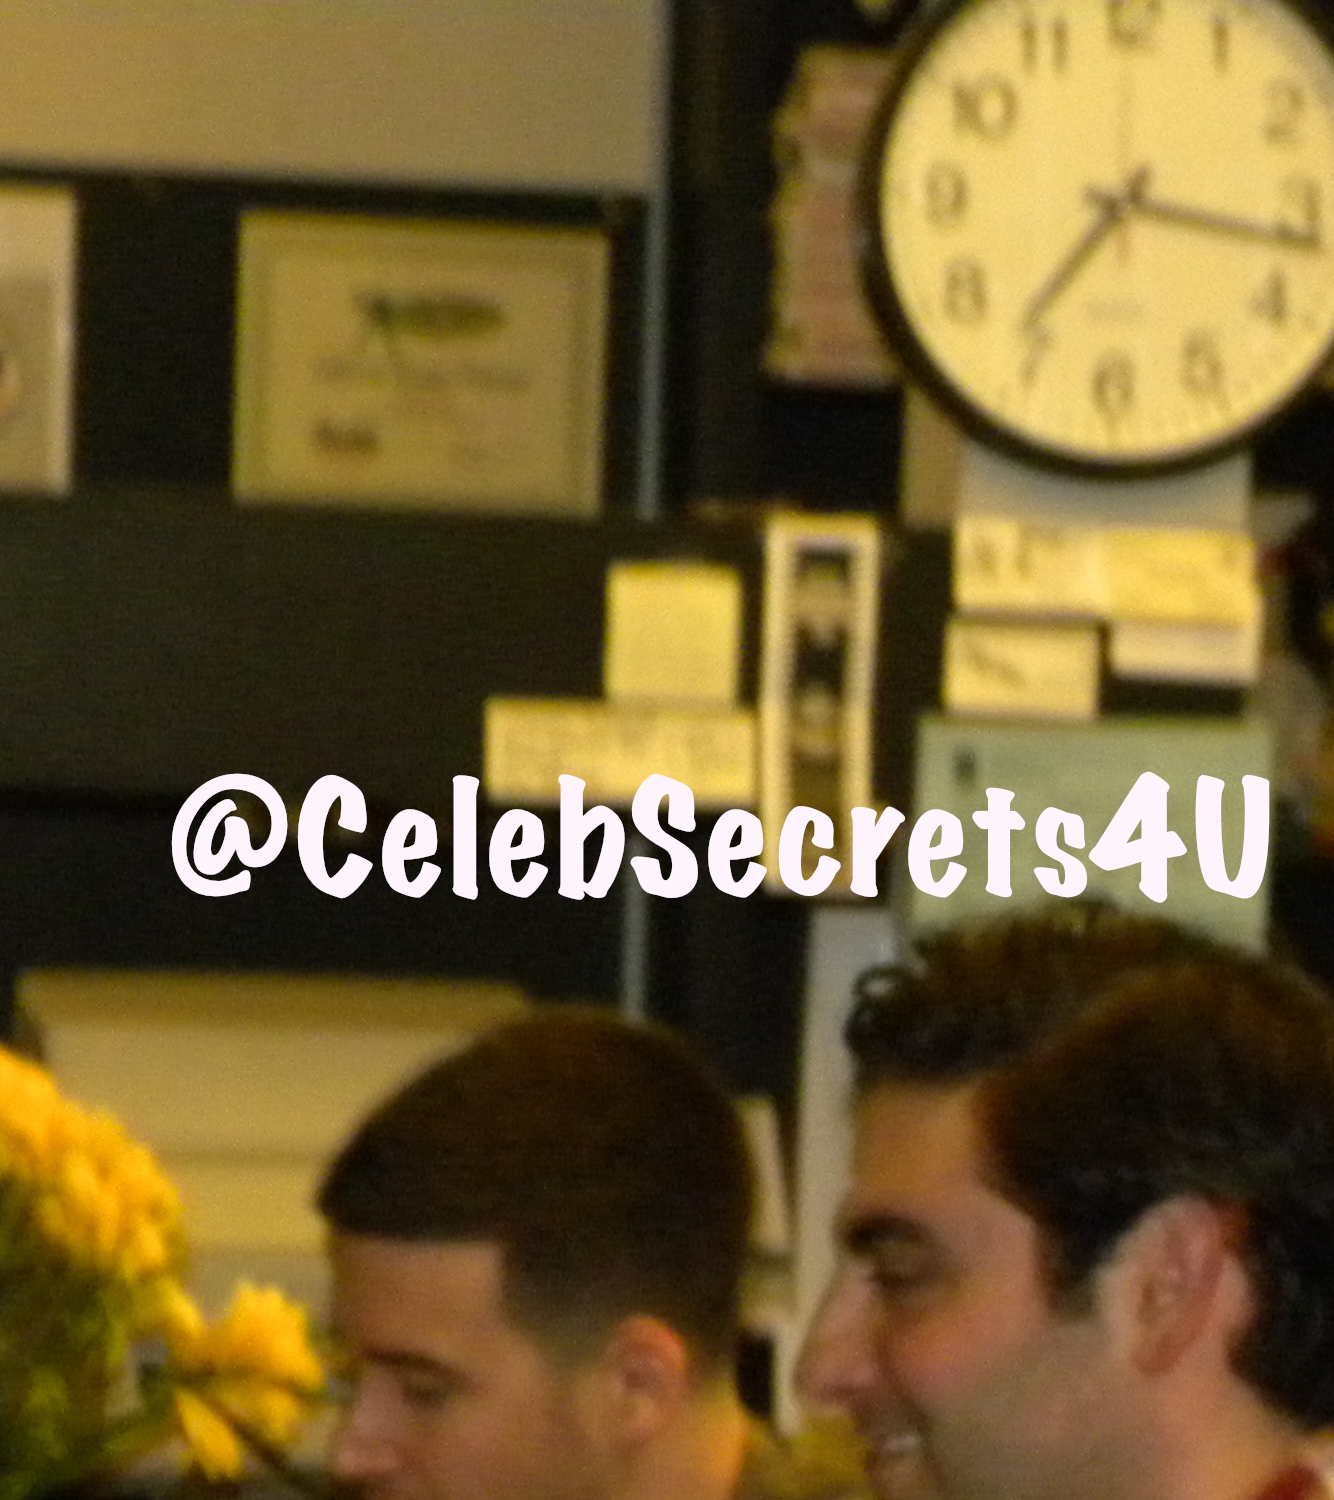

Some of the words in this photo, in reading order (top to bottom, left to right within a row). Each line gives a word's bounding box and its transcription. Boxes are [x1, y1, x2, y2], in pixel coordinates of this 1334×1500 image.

[1020, 16, 1069, 75] 11
[953, 73, 1018, 142] 10
[1263, 78, 1306, 149] 2
[924, 162, 968, 229] 9
[943, 258, 989, 325] 8
[1250, 270, 1287, 327] 4
[1092, 351, 1136, 416] 6
